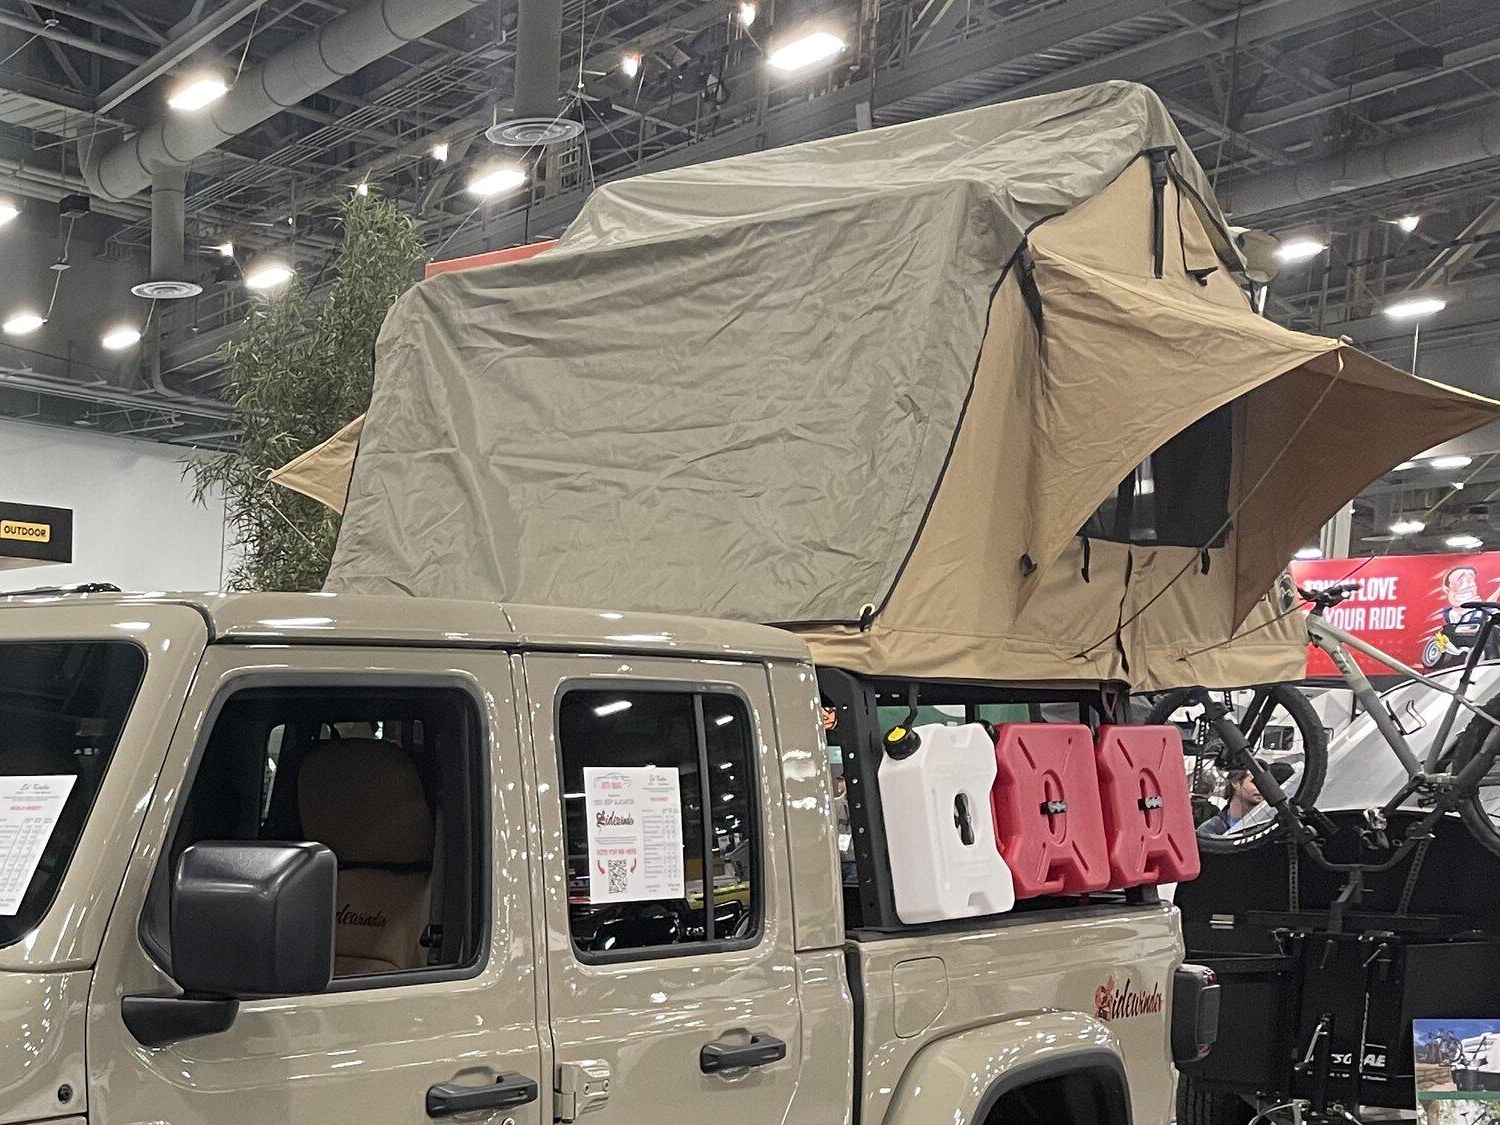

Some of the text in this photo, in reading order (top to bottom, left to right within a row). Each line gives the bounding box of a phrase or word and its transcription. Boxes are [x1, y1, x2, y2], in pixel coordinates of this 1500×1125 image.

[4, 525, 46, 537] OUTDOOR
[1360, 577, 1399, 601] LOVE
[1322, 607, 1365, 630] YOUR
[1369, 606, 1407, 629] RIDE
[1095, 974, 1163, 1023] Sidewinder
